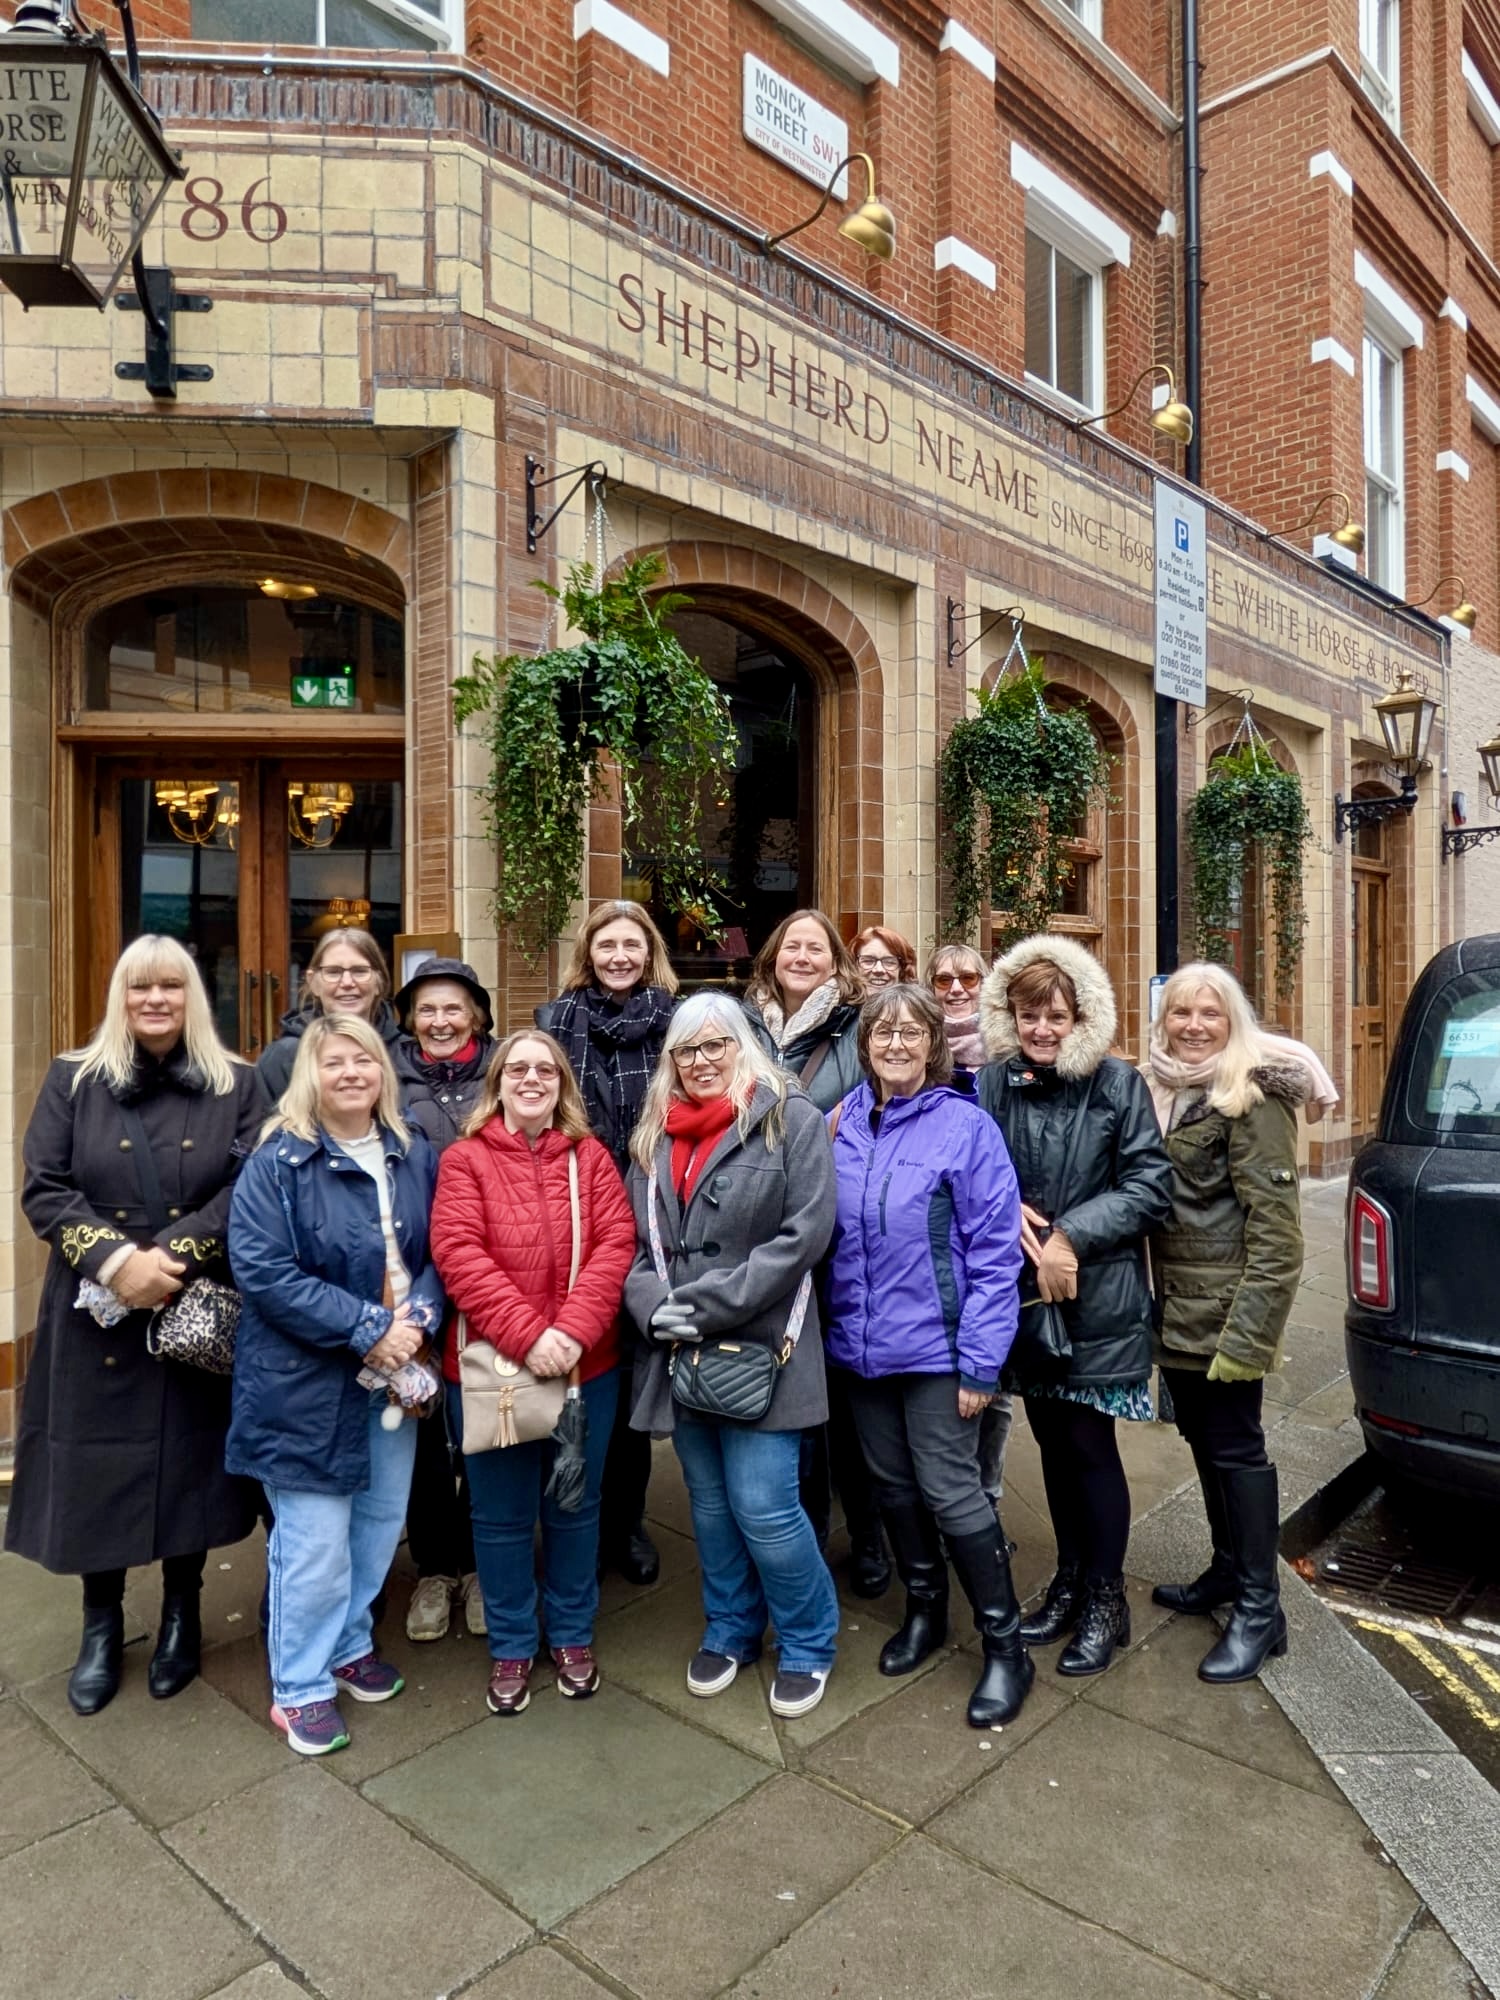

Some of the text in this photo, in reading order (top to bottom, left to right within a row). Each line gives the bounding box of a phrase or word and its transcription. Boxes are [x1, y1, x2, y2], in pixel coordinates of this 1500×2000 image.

[0, 69, 71, 102] ITE
[755, 68, 806, 121] MONCK
[0, 113, 67, 142] RSE
[755, 95, 841, 168] STREET SW1
[99, 89, 157, 193] WHITE
[4, 149, 23, 175] &
[755, 127, 827, 181] CITY OF WESTMINSTER
[92, 134, 144, 219] HORSE
[0, 183, 66, 206] WER
[180, 176, 288, 244] 86
[78, 196, 124, 260] BOWER
[617, 273, 890, 445] SHEPHERD
[916, 418, 1039, 519] NEAME
[1051, 500, 1110, 552] SINCE
[1119, 530, 1153, 572] 1698
[1206, 566, 1224, 607] E
[1233, 580, 1299, 643] WHITE
[1307, 617, 1360, 672] HORSE
[1367, 649, 1377, 679] &
[1171, 551, 1182, 564] Mon
[1186, 559, 1194, 569] Fri
[1167, 578, 1190, 597] Resident
[1173, 568, 1181, 577] am
[1197, 579, 1205, 588] pm
[1159, 589, 1177, 604] permit
[1178, 595, 1198, 612] holders
[1179, 613, 1185, 621] or
[1161, 631, 1173, 644] 020
[1165, 620, 1199, 643] Pay by phone
[1173, 649, 1191, 663] or text
[1160, 669, 1202, 690] quoting location
[1449, 1032, 1480, 1041] 66351
